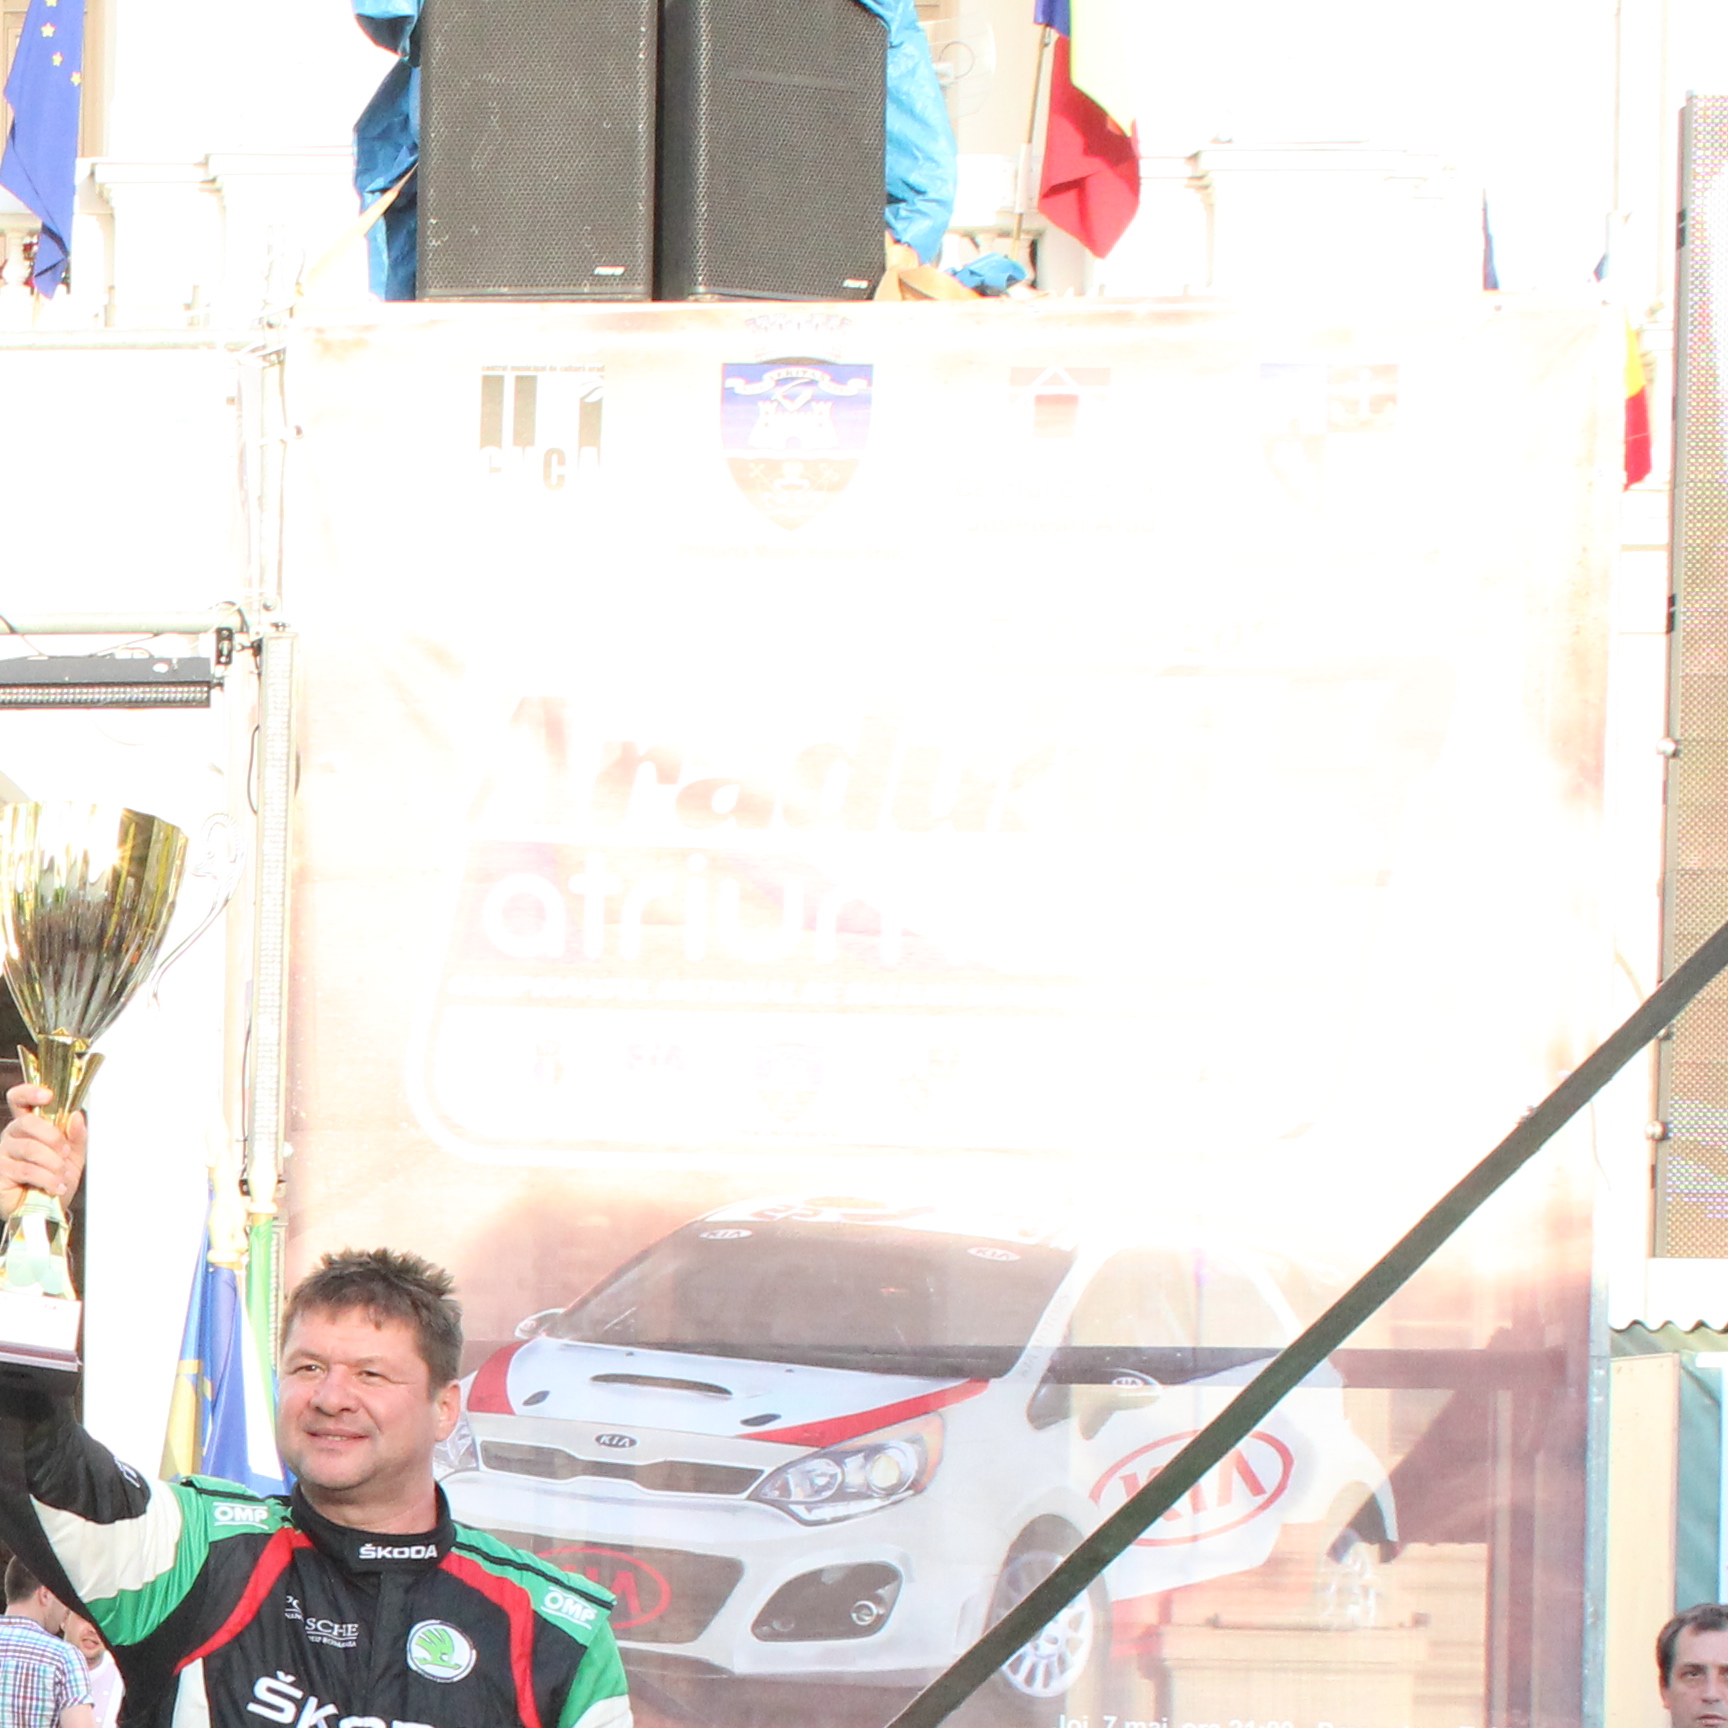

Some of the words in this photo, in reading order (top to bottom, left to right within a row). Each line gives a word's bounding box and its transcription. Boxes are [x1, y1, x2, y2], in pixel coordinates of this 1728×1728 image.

[598, 1434, 635, 1448] KIA
[213, 1506, 270, 1526] OMP
[358, 1542, 439, 1561] ŠKODA
[542, 1589, 598, 1624] OMP
